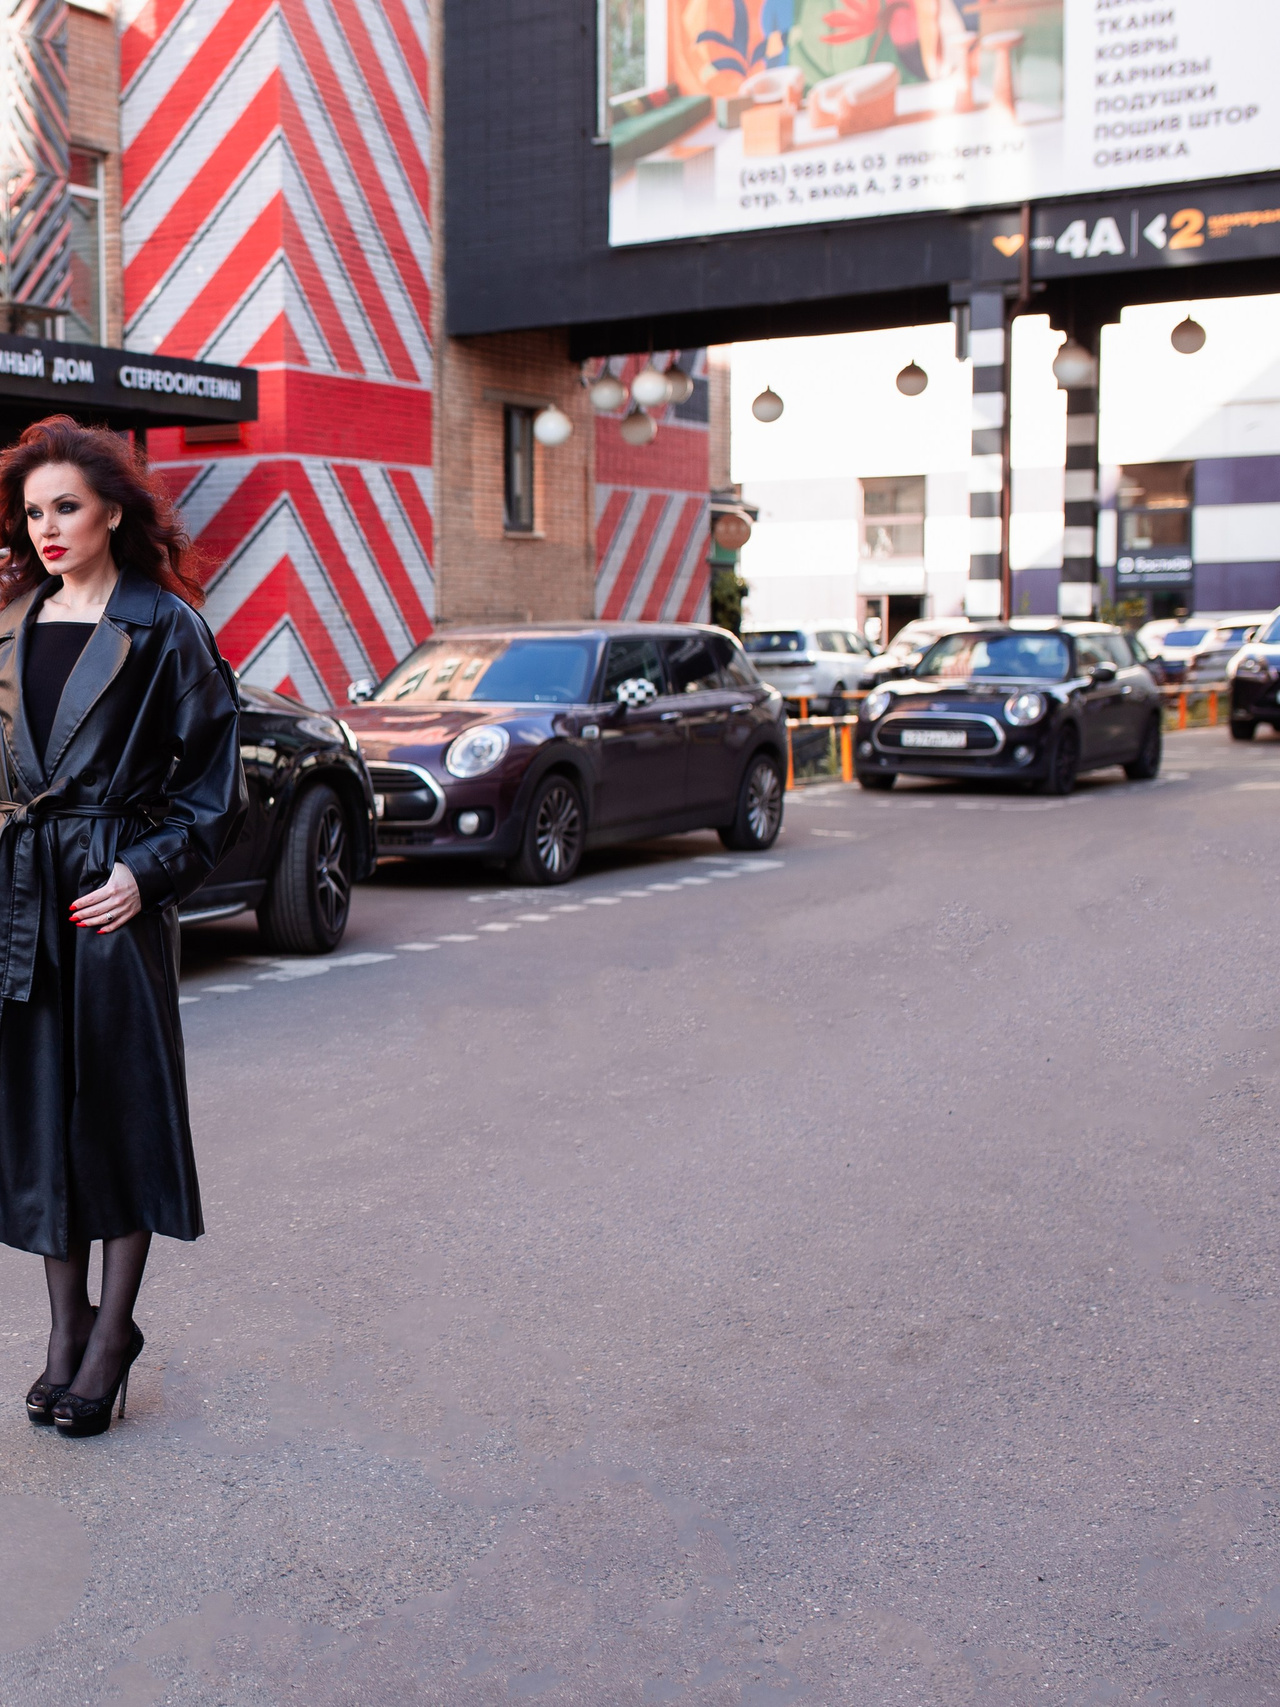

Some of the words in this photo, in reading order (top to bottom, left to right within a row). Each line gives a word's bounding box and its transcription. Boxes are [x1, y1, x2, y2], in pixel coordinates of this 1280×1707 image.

[1096, 10, 1174, 34] ТКАНИ
[1095, 36, 1178, 61] КОВРЫ
[1095, 57, 1212, 87] КАРНИЗЫ
[1095, 84, 1216, 113] ПОДУШКИ
[1094, 114, 1181, 140] ПОШИВ
[1188, 103, 1260, 129] ШТОР
[1093, 141, 1189, 168] ОБИВКА
[809, 182, 859, 201] вход
[1168, 208, 1205, 250] 2
[51, 356, 95, 384] ДОМ
[119, 364, 242, 401] СТЕРЕОСИСТЕМЫ
